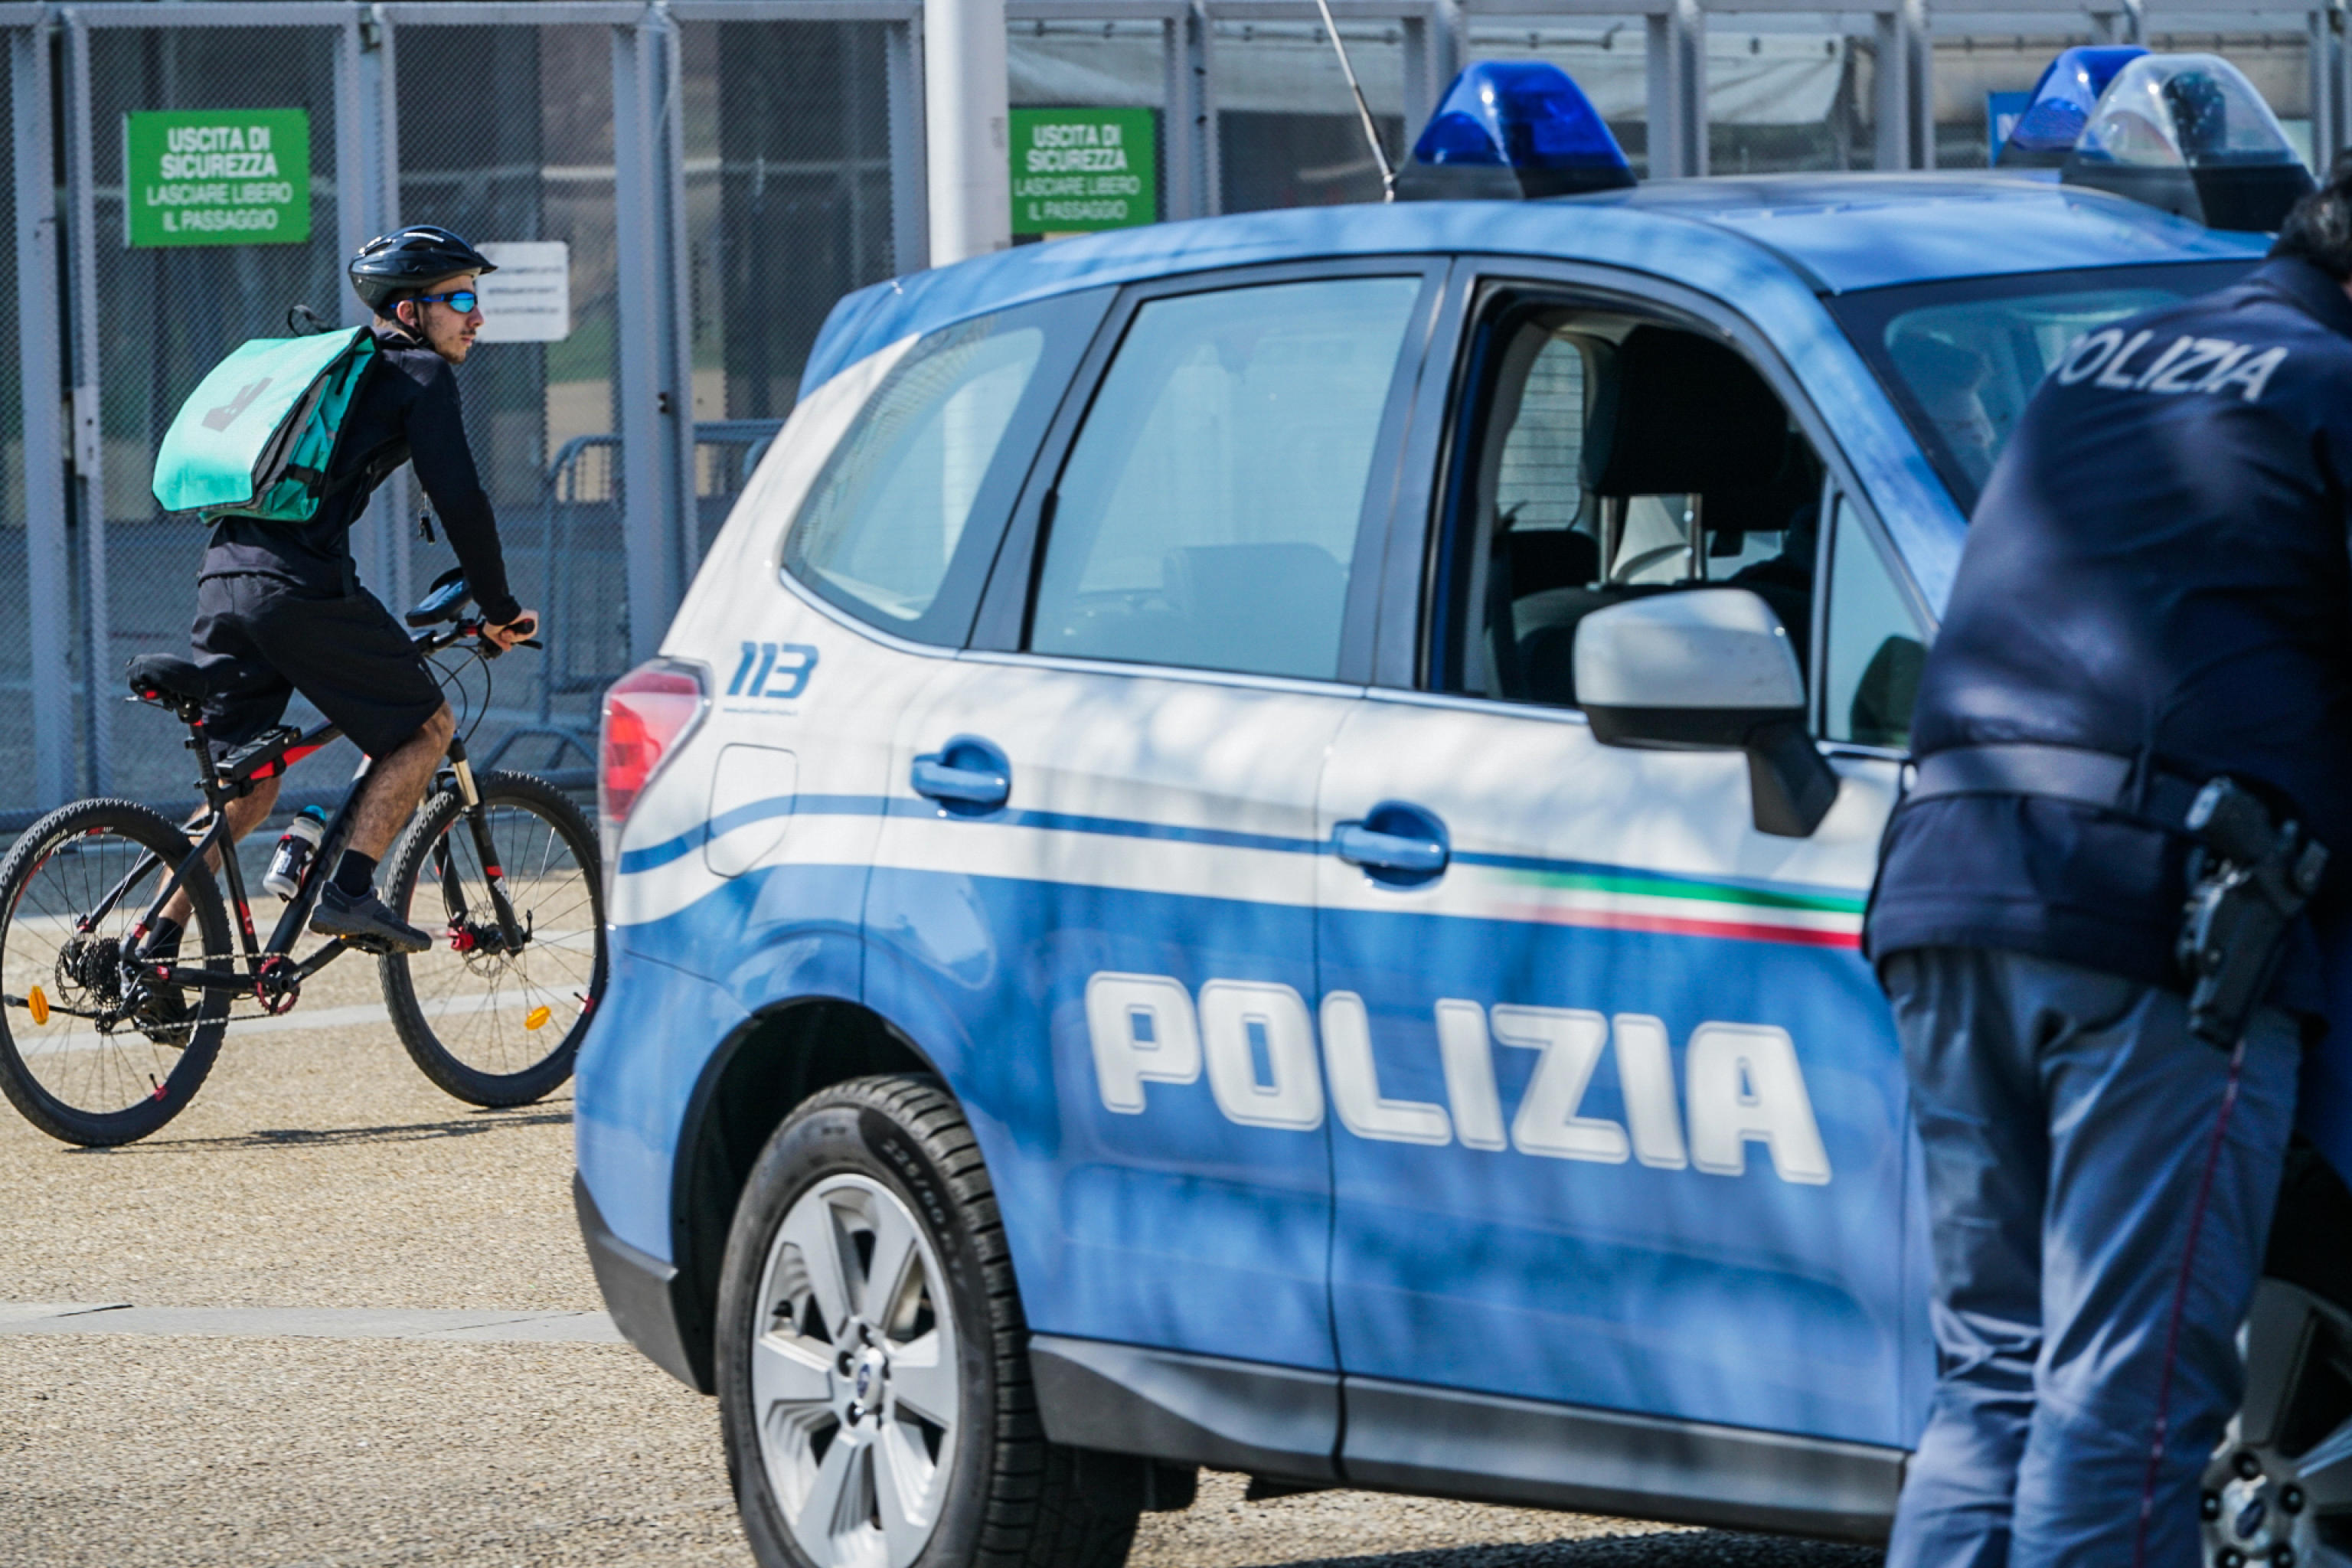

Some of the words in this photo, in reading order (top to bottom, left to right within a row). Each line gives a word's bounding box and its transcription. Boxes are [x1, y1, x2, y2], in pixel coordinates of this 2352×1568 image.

[168, 127, 245, 152] USCITA
[248, 126, 270, 151] DI
[1034, 124, 1098, 147] USCITA
[1101, 124, 1122, 146] DI
[160, 152, 278, 180] SICUREZZA
[1027, 149, 1128, 172] SICUREZZA
[146, 184, 229, 206] LASCIARE
[231, 181, 293, 204] LIBERO
[1014, 177, 1084, 196] LASCIARE
[1087, 175, 1141, 195] LIBERO
[162, 211, 178, 231] IL
[181, 207, 278, 230] PASSAGGIO
[1028, 202, 1041, 220] IL
[1044, 200, 1129, 220] PASSAGGIO
[726, 641, 819, 699] 113
[1084, 970, 1833, 1187] POLIZIA
